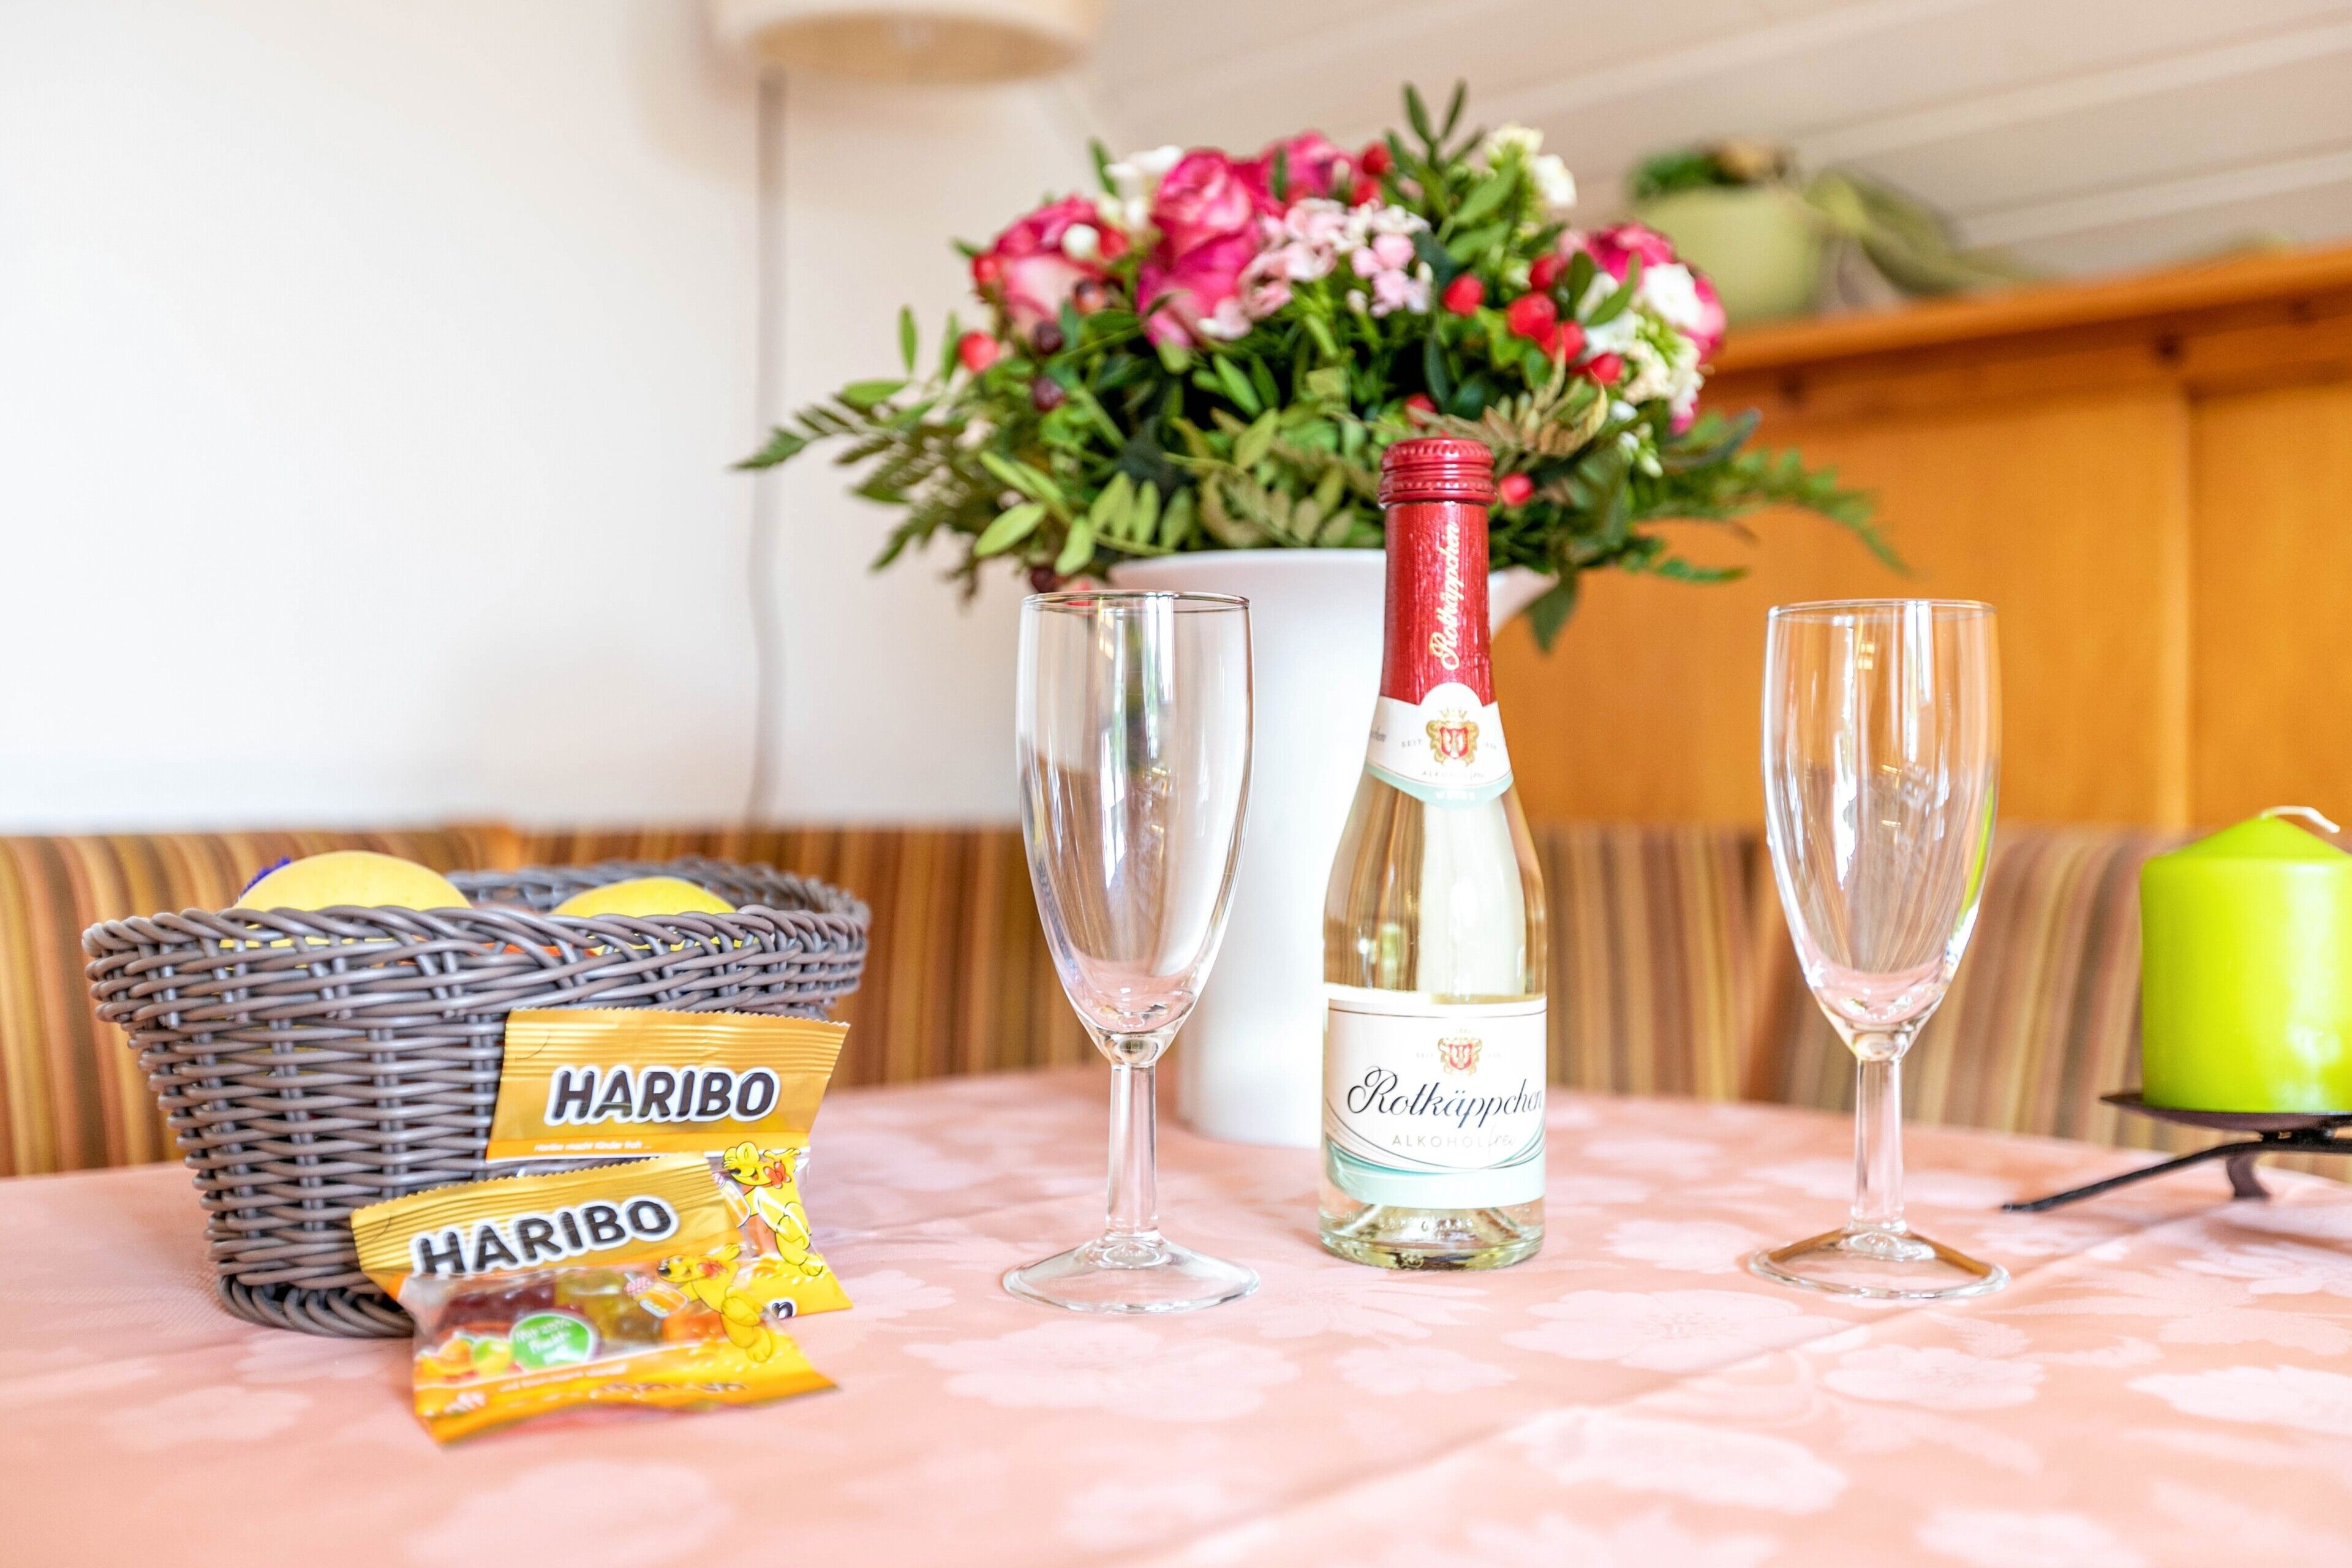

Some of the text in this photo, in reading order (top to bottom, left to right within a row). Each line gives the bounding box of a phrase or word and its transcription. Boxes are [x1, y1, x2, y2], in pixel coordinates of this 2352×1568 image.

[1430, 523, 1464, 671] Rotkäppchen
[548, 1068, 777, 1121] HARIBO
[1347, 1066, 1543, 1128] Rotkäppchen
[413, 1198, 674, 1276] HARIBO
